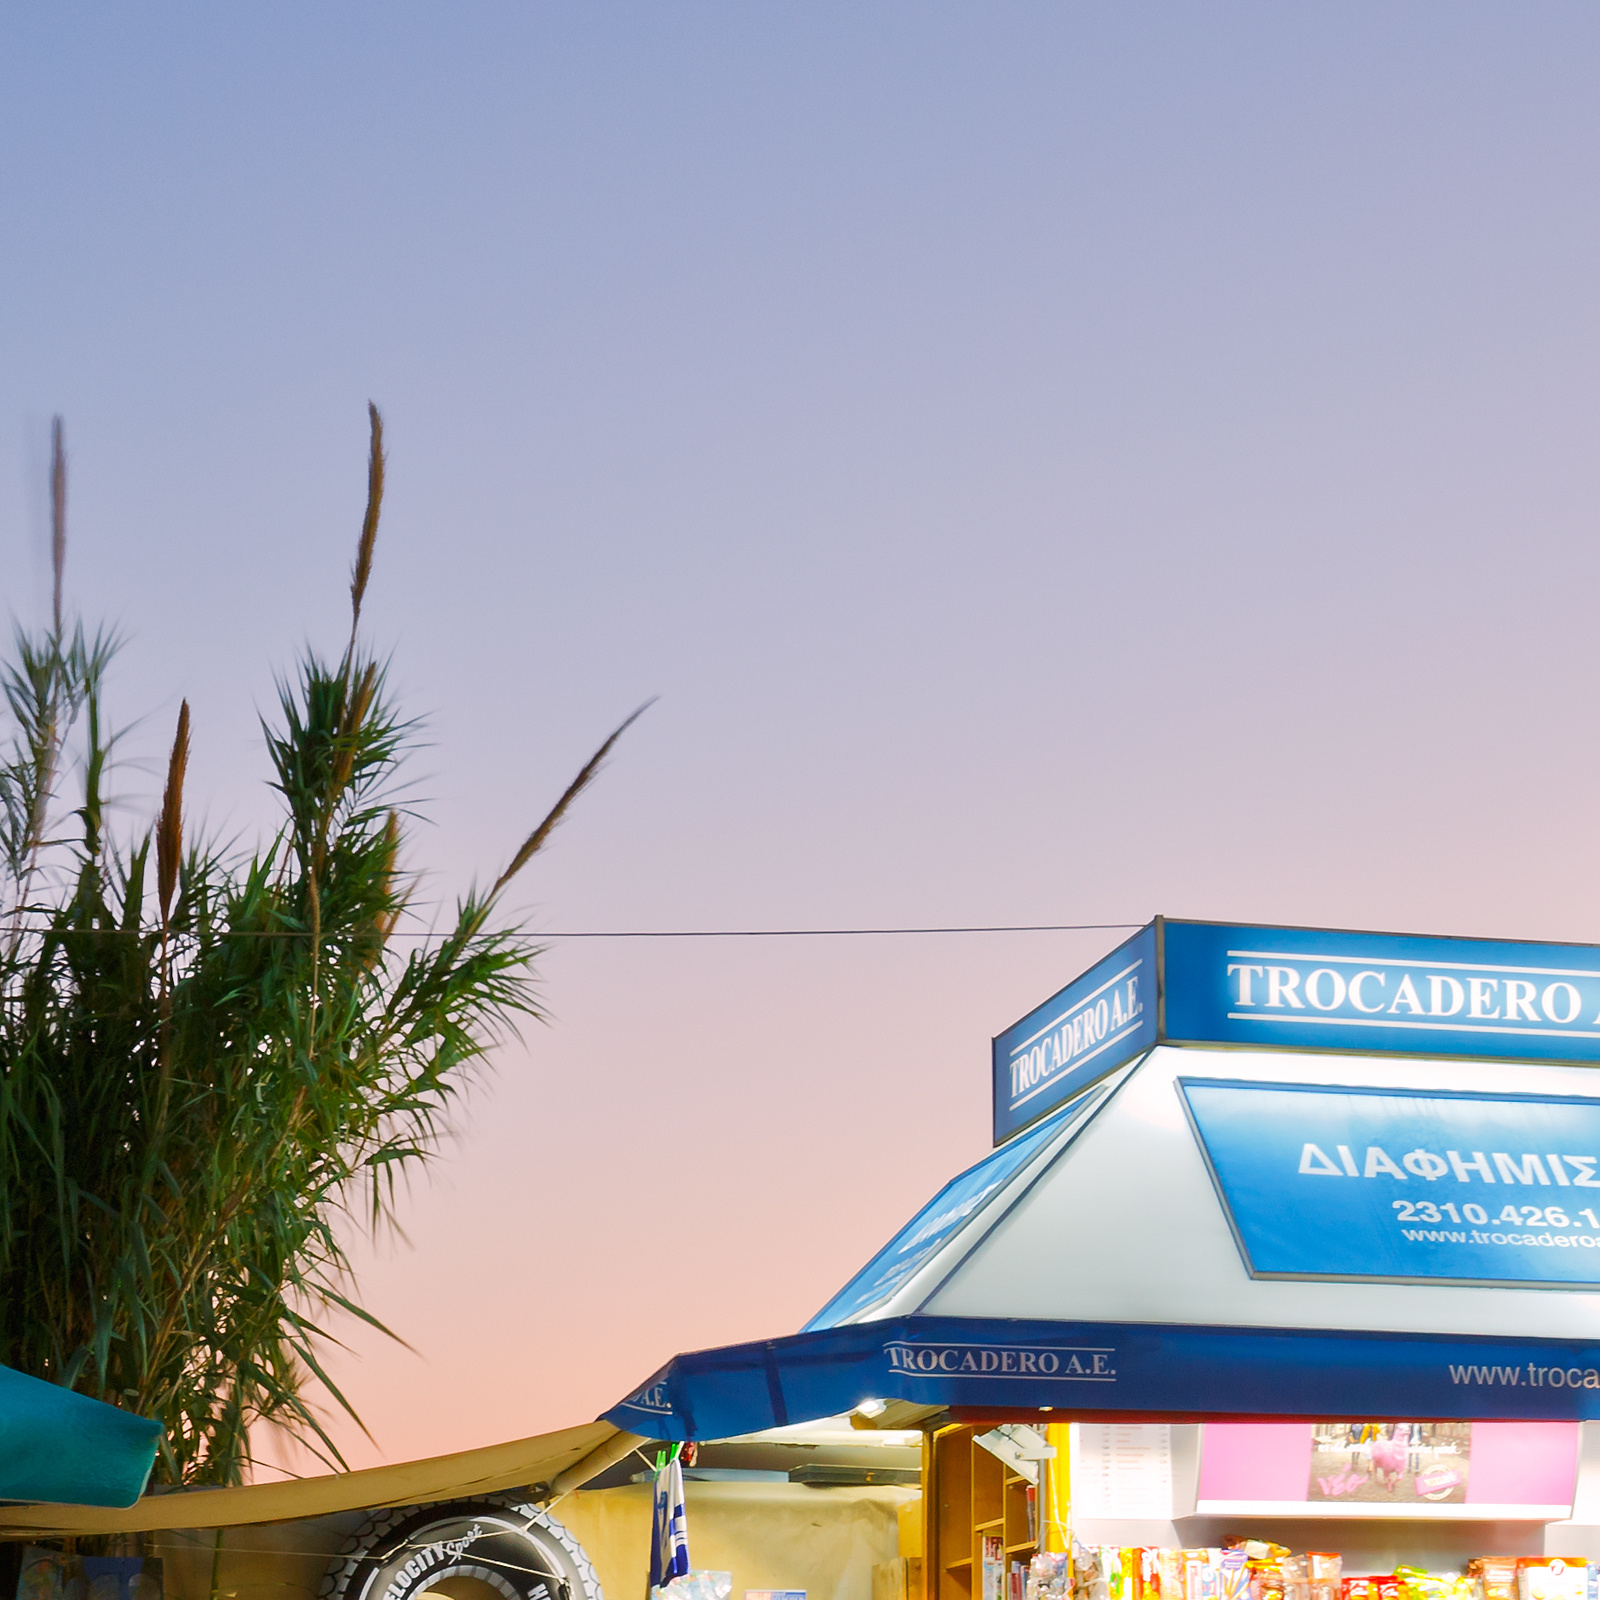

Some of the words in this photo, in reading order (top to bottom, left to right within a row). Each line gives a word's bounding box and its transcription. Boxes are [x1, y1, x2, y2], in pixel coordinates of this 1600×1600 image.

[1227, 963, 1582, 1023] TROCADERO
[1009, 998, 1109, 1099] TROCADERO
[1110, 974, 1144, 1033] A.E.
[883, 1346, 1064, 1375] TROCADERO
[1067, 1353, 1117, 1375] A.E.
